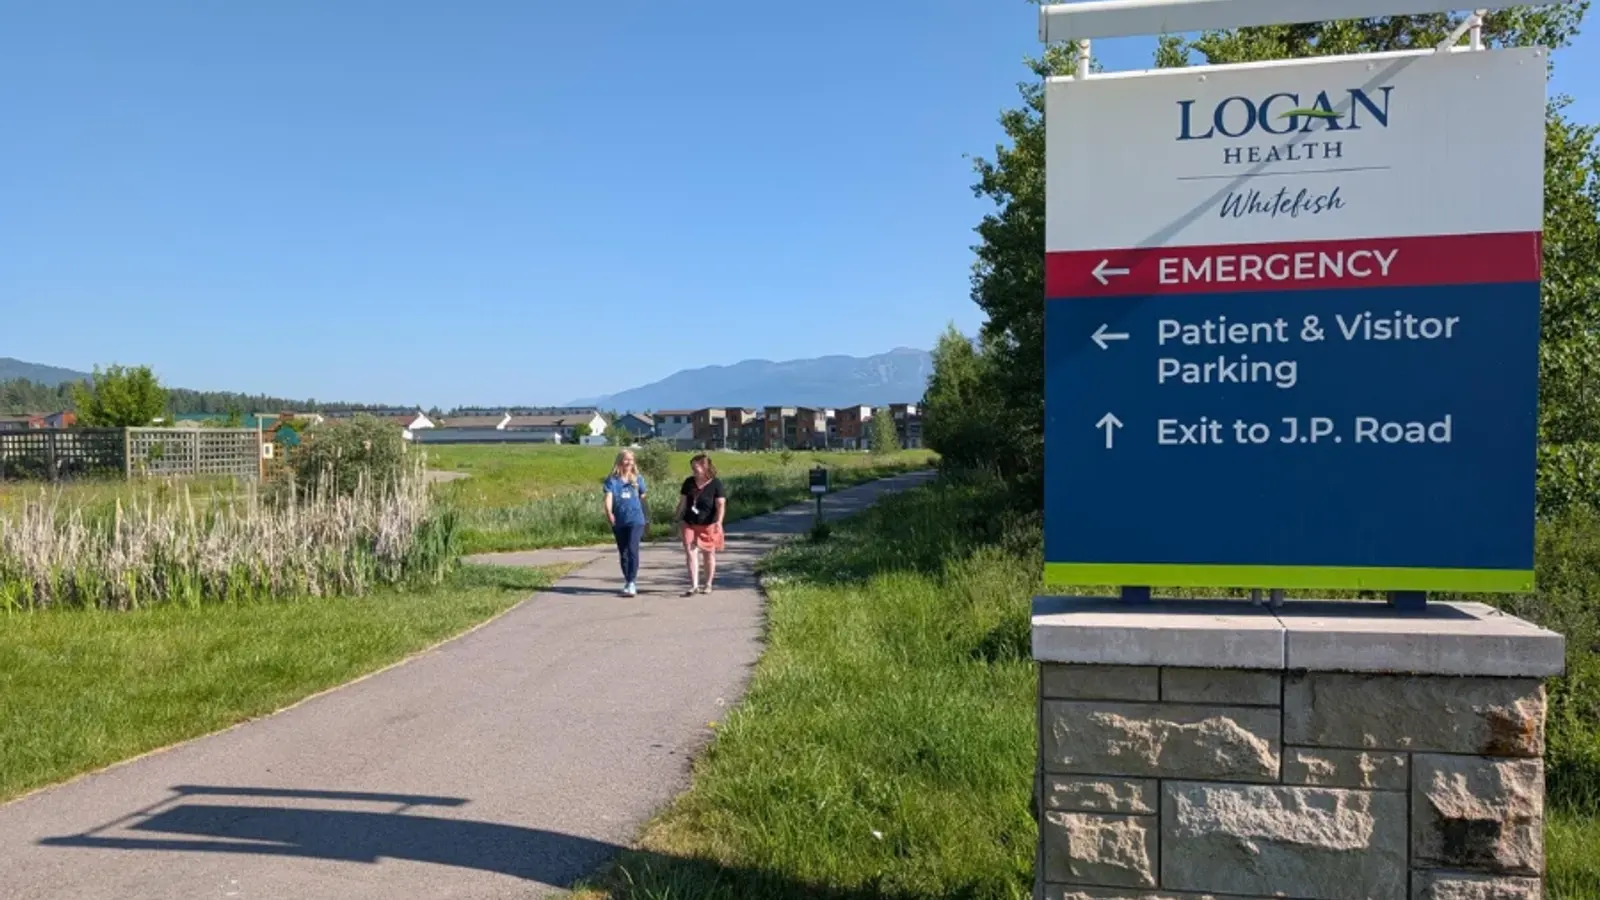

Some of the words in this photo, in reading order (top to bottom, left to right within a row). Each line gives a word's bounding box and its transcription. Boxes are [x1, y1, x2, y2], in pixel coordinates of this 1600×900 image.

[1176, 86, 1395, 142] LOGAN
[1223, 141, 1343, 164] HEALTH
[1219, 186, 1346, 219] Whitefish
[1158, 248, 1399, 284] EMERGENCY
[1158, 316, 1289, 346] Patient
[1300, 315, 1325, 342] &
[1335, 311, 1460, 341] Visitor
[1158, 354, 1299, 389] Parking
[1157, 417, 1223, 446] Exit
[1233, 419, 1270, 444] to
[1280, 416, 1342, 444] J.P.
[1355, 414, 1453, 444] Road
